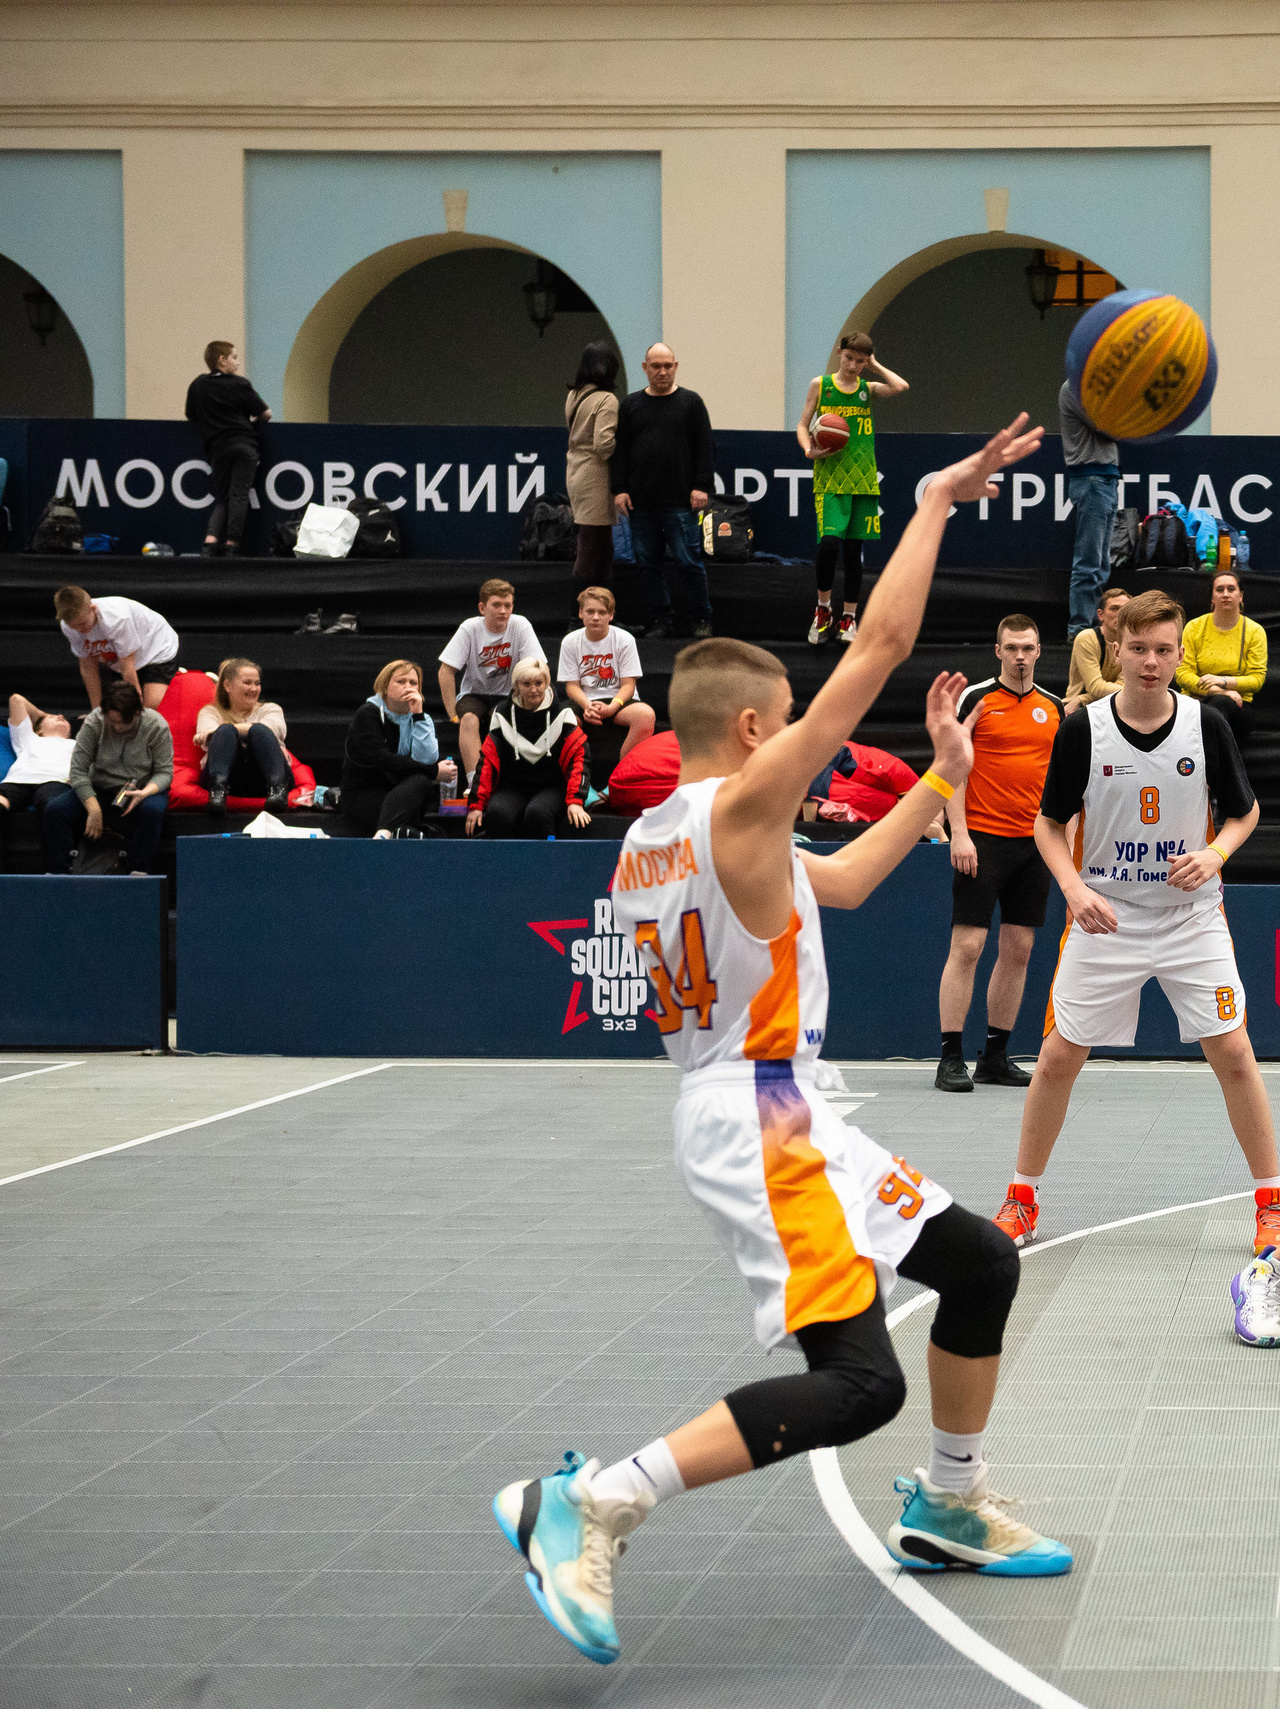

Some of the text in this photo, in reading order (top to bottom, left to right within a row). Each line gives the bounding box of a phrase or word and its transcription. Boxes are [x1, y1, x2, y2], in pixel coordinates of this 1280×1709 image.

[857, 417, 872, 435] 78
[55, 453, 545, 514] МОСОВСКИЙ
[865, 515, 881, 534] 78
[1139, 786, 1160, 825] 8
[1114, 841, 1149, 863] УОР
[1088, 866, 1169, 882] им. А.Я. Гоме
[571, 936, 647, 979] SQUA
[592, 978, 648, 1016] CUP
[1215, 986, 1237, 1021] 8
